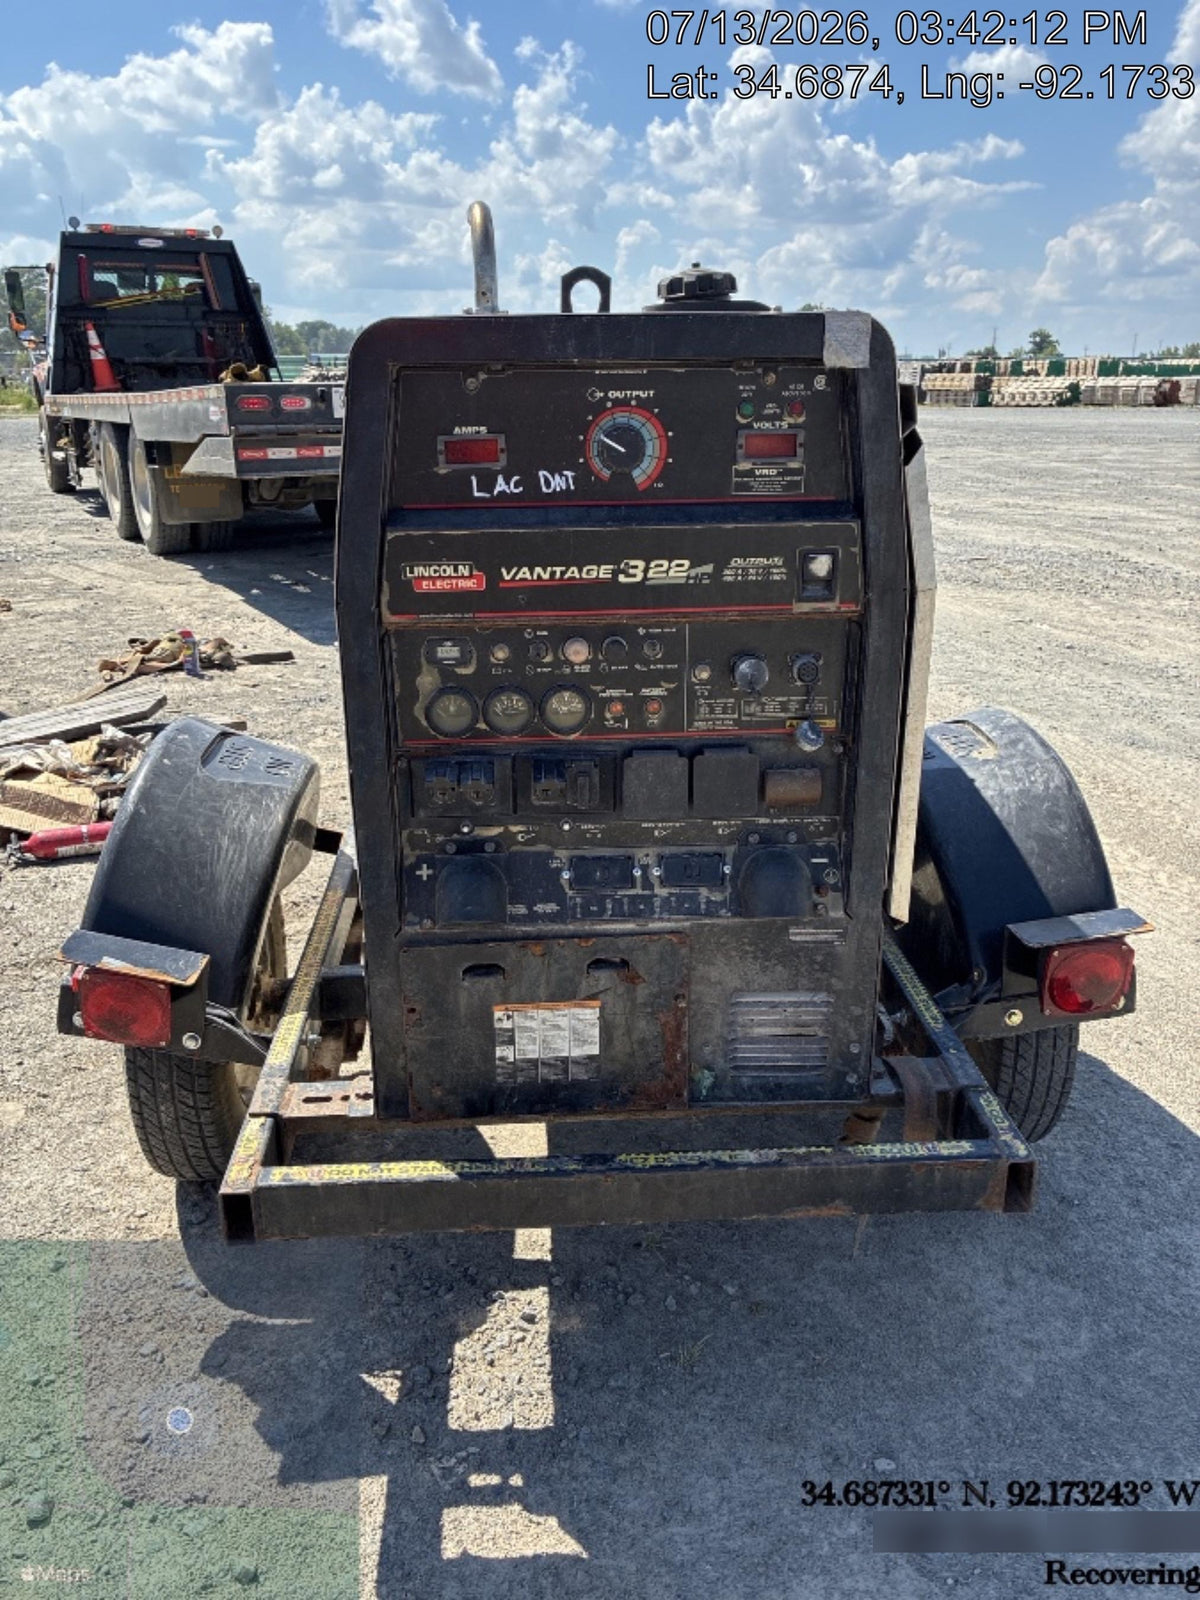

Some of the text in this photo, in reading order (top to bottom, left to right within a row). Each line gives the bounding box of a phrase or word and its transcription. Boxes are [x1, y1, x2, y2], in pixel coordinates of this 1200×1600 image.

[608, 390, 655, 398] OUTPUT
[753, 421, 788, 429] VOLTS
[453, 426, 488, 435] AMPS
[406, 564, 470, 577] LINCOLN
[501, 559, 691, 583] VANTAGE 322
[422, 578, 478, 590] ELECTRIC
